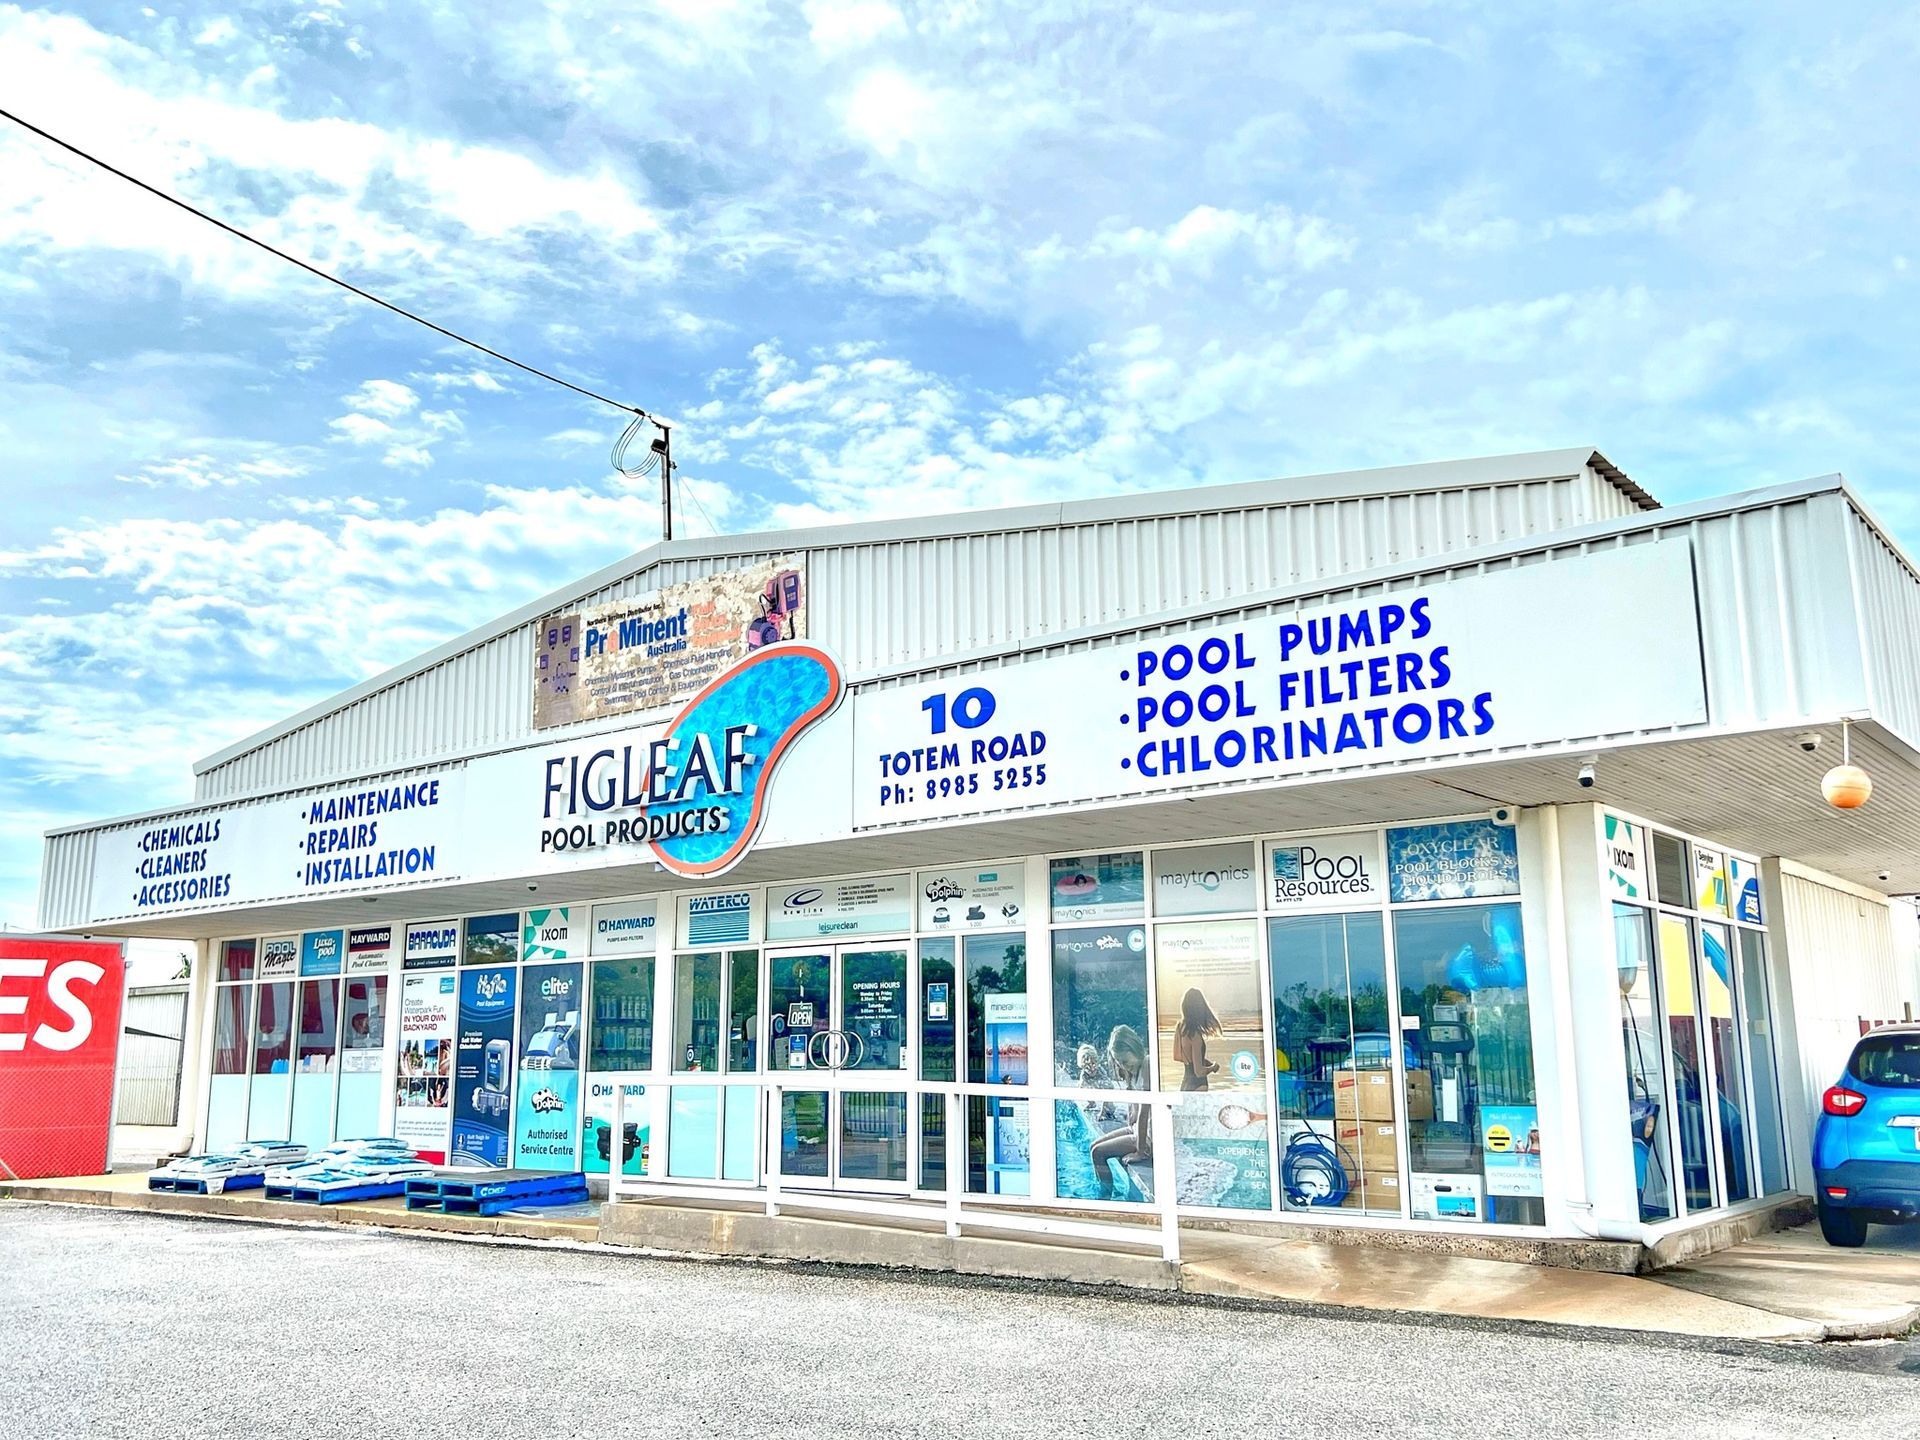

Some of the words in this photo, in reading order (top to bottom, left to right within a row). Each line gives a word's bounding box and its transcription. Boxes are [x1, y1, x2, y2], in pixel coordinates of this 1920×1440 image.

[647, 638, 687, 658] Australia
[1137, 633, 1256, 687] POOL
[1280, 597, 1431, 662] PUMPS
[1137, 680, 1256, 733] POOL
[1280, 645, 1452, 712] FILTERS
[922, 687, 997, 735] 10
[1136, 691, 1495, 778] CHLORINATORS
[879, 743, 960, 778] TOTEM
[971, 730, 1047, 764] ROAD
[543, 724, 754, 818] FIGLEAF
[880, 784, 914, 806] Ph:
[926, 773, 979, 800] 8985
[993, 763, 1047, 791] 5255
[309, 780, 440, 825] MAINTENANCE
[143, 818, 221, 852] CHEMICALS
[541, 824, 596, 852] POOL
[605, 806, 724, 845] PRODUCTS
[306, 821, 378, 856] REPAIRS
[140, 849, 208, 879] CLEANERS
[304, 845, 436, 886] INSTALLATION
[1395, 861, 1434, 874] POOL
[1439, 855, 1499, 871] BLOCKS
[1502, 855, 1513, 869] &
[1160, 865, 1250, 891] maytronics
[1402, 873, 1452, 887] LIQUID
[1457, 868, 1508, 882] DROPS
[138, 873, 231, 907] ACCESSORIES
[930, 886, 964, 901] Dolphin
[1274, 878, 1370, 898] Resources
[689, 893, 750, 910] WATERCO
[1055, 908, 1097, 919] maytronics
[608, 916, 656, 931] HAYWARD
[818, 921, 859, 932] leisureclean
[350, 932, 390, 944] HAYWARD
[408, 928, 456, 951] BARACUDA
[265, 940, 297, 954] POOL
[317, 944, 336, 960] pool
[1055, 942, 1093, 952] maytronics
[264, 952, 296, 968] Magic
[351, 960, 364, 968] Pool
[852, 982, 879, 990] OPENING
[879, 981, 900, 989] HOURS
[411, 1014, 430, 1022] YOUR
[430, 1014, 447, 1022] OWN
[791, 1011, 811, 1025] OPEN
[403, 1023, 437, 1031] BACKYARD
[534, 1097, 565, 1113] Dolphin
[527, 1129, 568, 1140] Authorised
[520, 1143, 548, 1155] Service
[548, 1144, 574, 1156] Centre
[1217, 1147, 1265, 1156] EXPERIENCE
[1250, 1158, 1266, 1167] THE
[1244, 1169, 1267, 1178] DEAD
[1250, 1181, 1267, 1190] SEA
